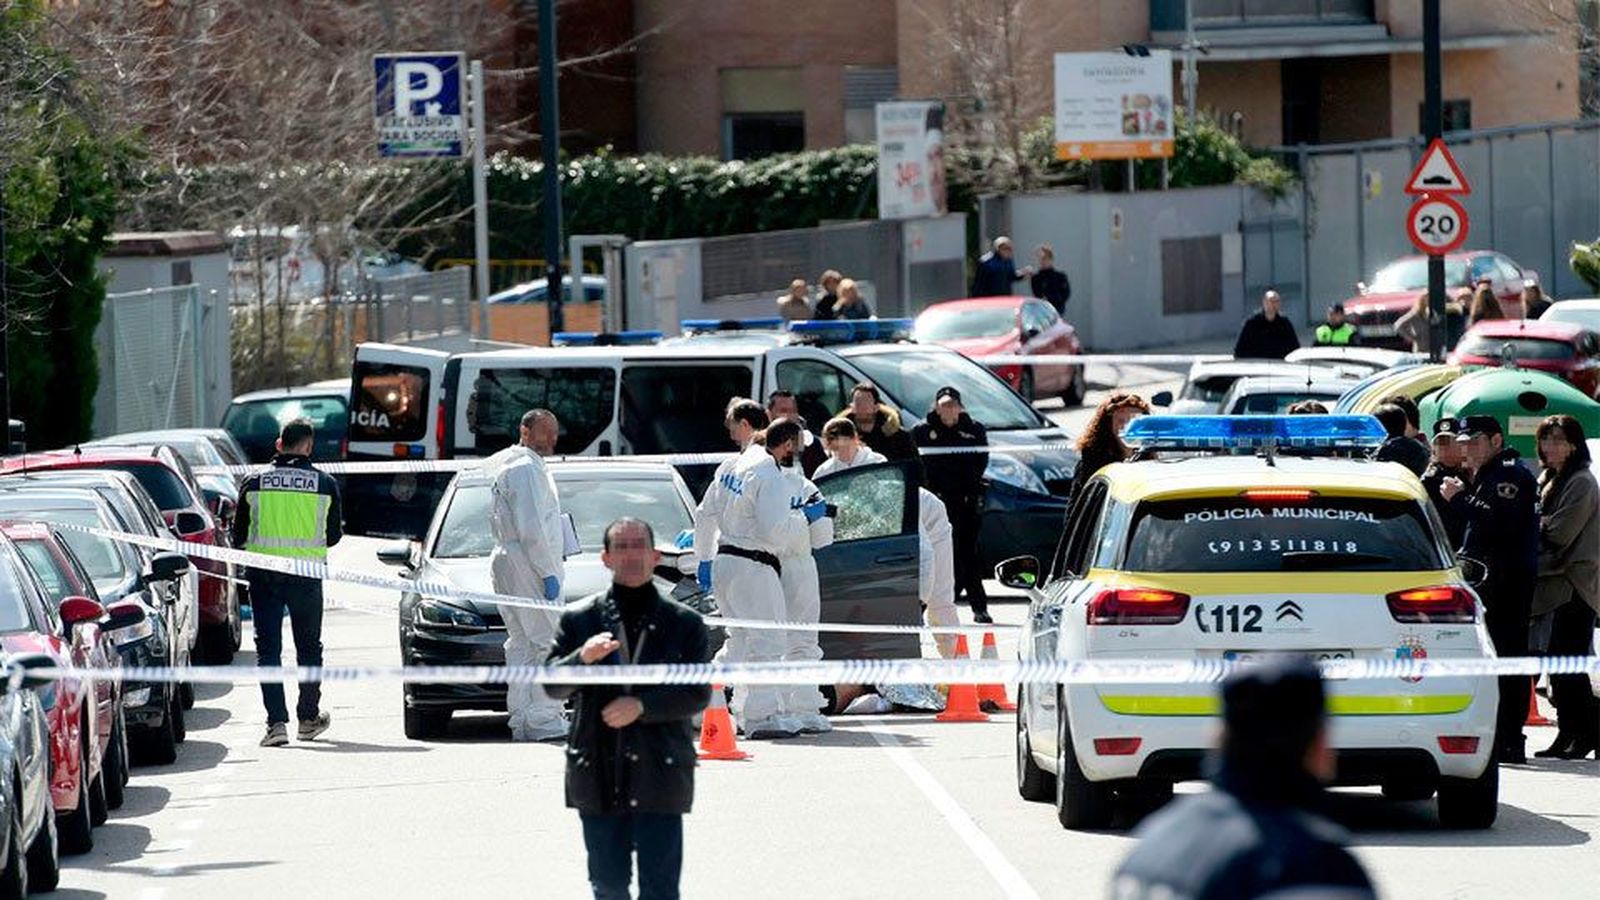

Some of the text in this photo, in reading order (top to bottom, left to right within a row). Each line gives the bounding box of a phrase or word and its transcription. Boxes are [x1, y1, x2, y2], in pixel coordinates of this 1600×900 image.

[394, 61, 443, 117] P
[1420, 215, 1454, 235] 20
[262, 475, 316, 490] POLICIA
[1272, 507, 1381, 524] MUNICIPAL
[1210, 603, 1263, 633] 112
